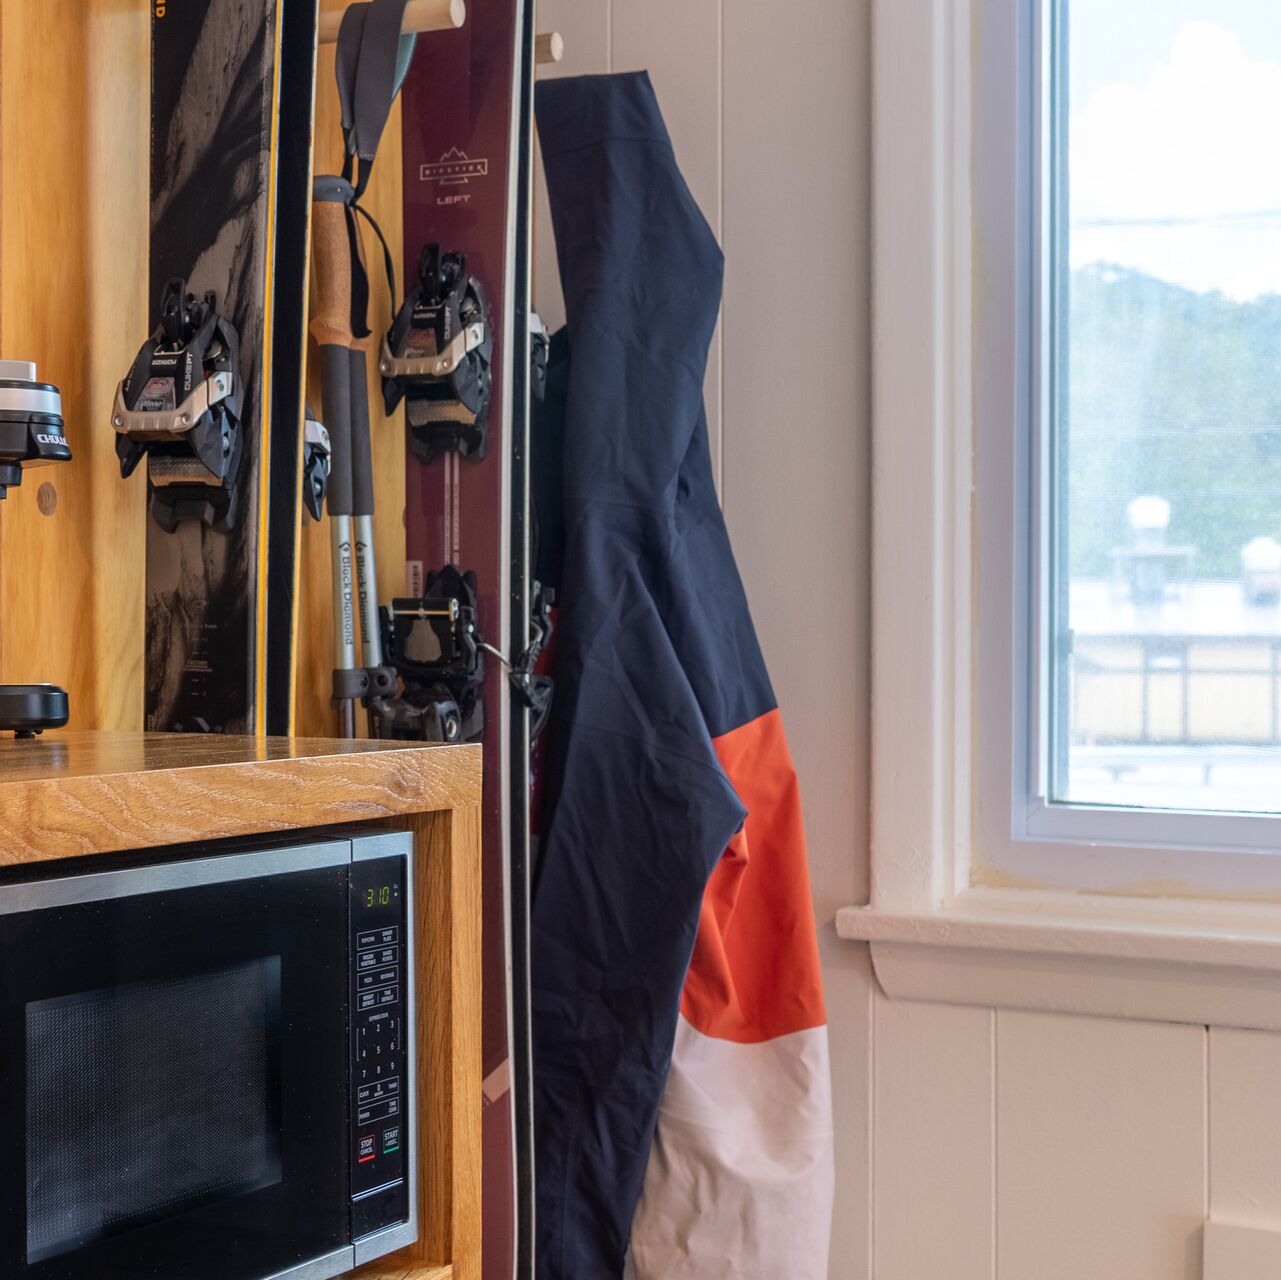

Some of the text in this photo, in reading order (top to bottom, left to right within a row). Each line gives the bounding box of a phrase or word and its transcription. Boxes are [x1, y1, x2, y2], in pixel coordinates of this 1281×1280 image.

[436, 194, 471, 205] LEFT
[186, 352, 194, 364] PT
[342, 556, 353, 645] Black Diamond
[384, 1129, 398, 1141] START
[360, 1138, 373, 1149] STOP
[360, 1146, 373, 1155] CANCEL
